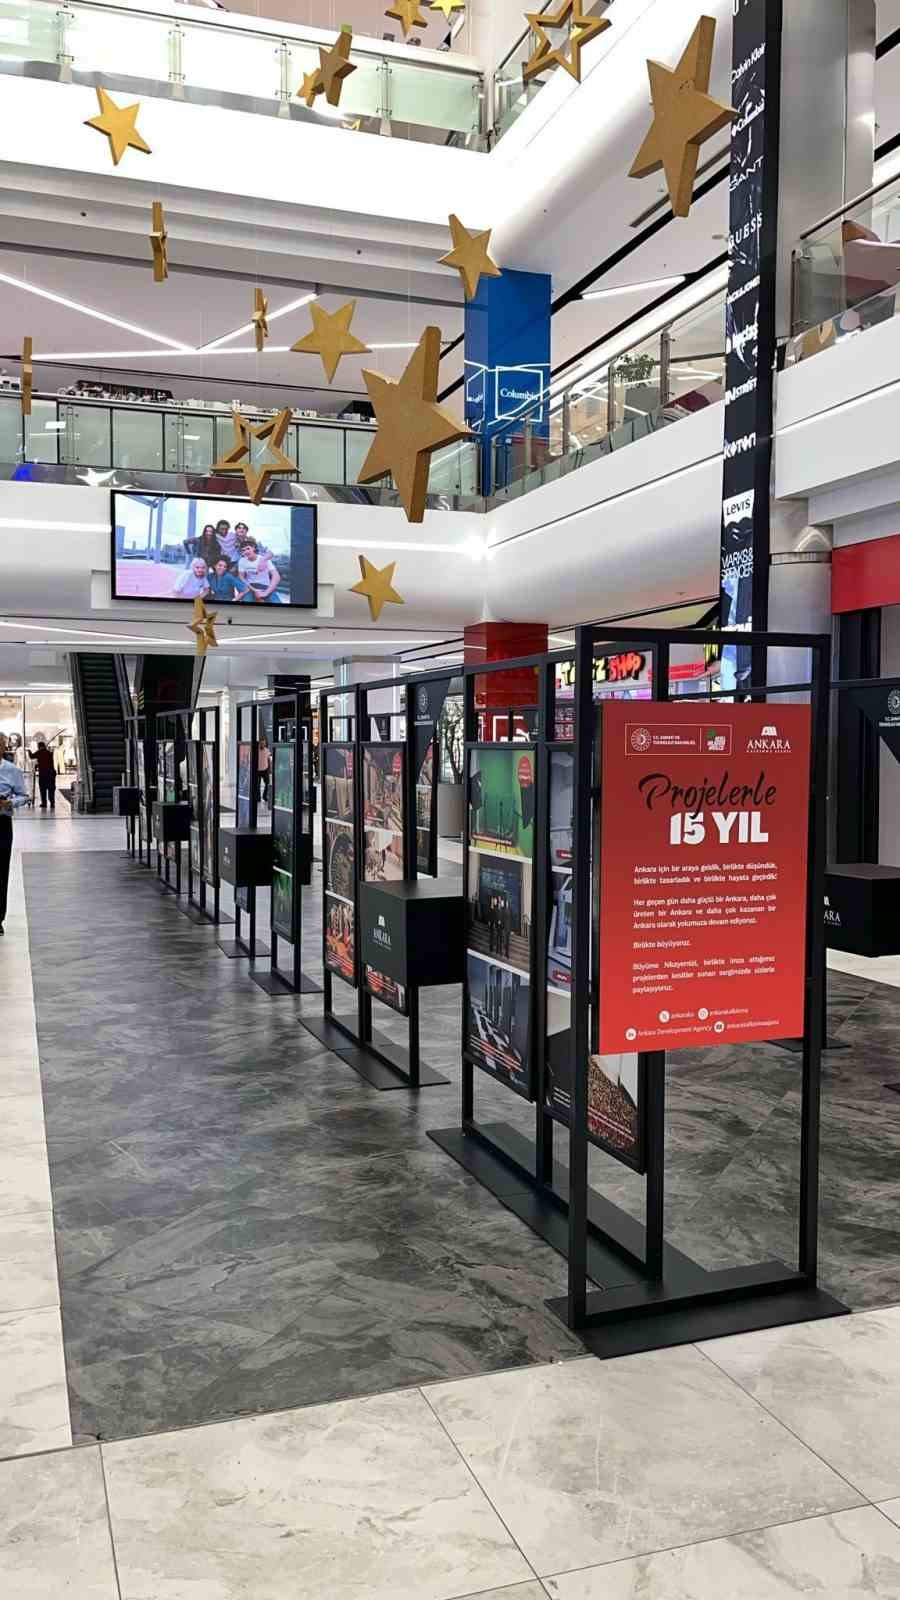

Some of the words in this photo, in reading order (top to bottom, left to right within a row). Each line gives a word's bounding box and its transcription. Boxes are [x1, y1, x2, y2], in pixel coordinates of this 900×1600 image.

[608, 651, 643, 682] SHOP
[746, 739, 791, 749] ANKARA
[638, 769, 777, 820] Projelerle
[669, 811, 705, 845] 15
[711, 811, 769, 844] YIL
[634, 865, 657, 873] Ankara
[658, 865, 670, 874] için
[671, 864, 681, 872] bir
[728, 874, 749, 882] hayata
[633, 898, 645, 906] Her
[646, 899, 666, 908] geçen
[666, 899, 679, 907] gün
[679, 897, 696, 905] daha
[715, 895, 725, 904] bir
[725, 894, 748, 904] Ankara,
[749, 893, 765, 902] daha
[657, 909, 667, 917] bir
[670, 909, 693, 917] Ankara
[706, 907, 722, 915] daha
[725, 907, 737, 916] çok
[633, 921, 656, 930] Ankara
[708, 917, 729, 927] devam
[633, 941, 656, 949] Birlikte
[637, 1029, 656, 1037] Ankara
